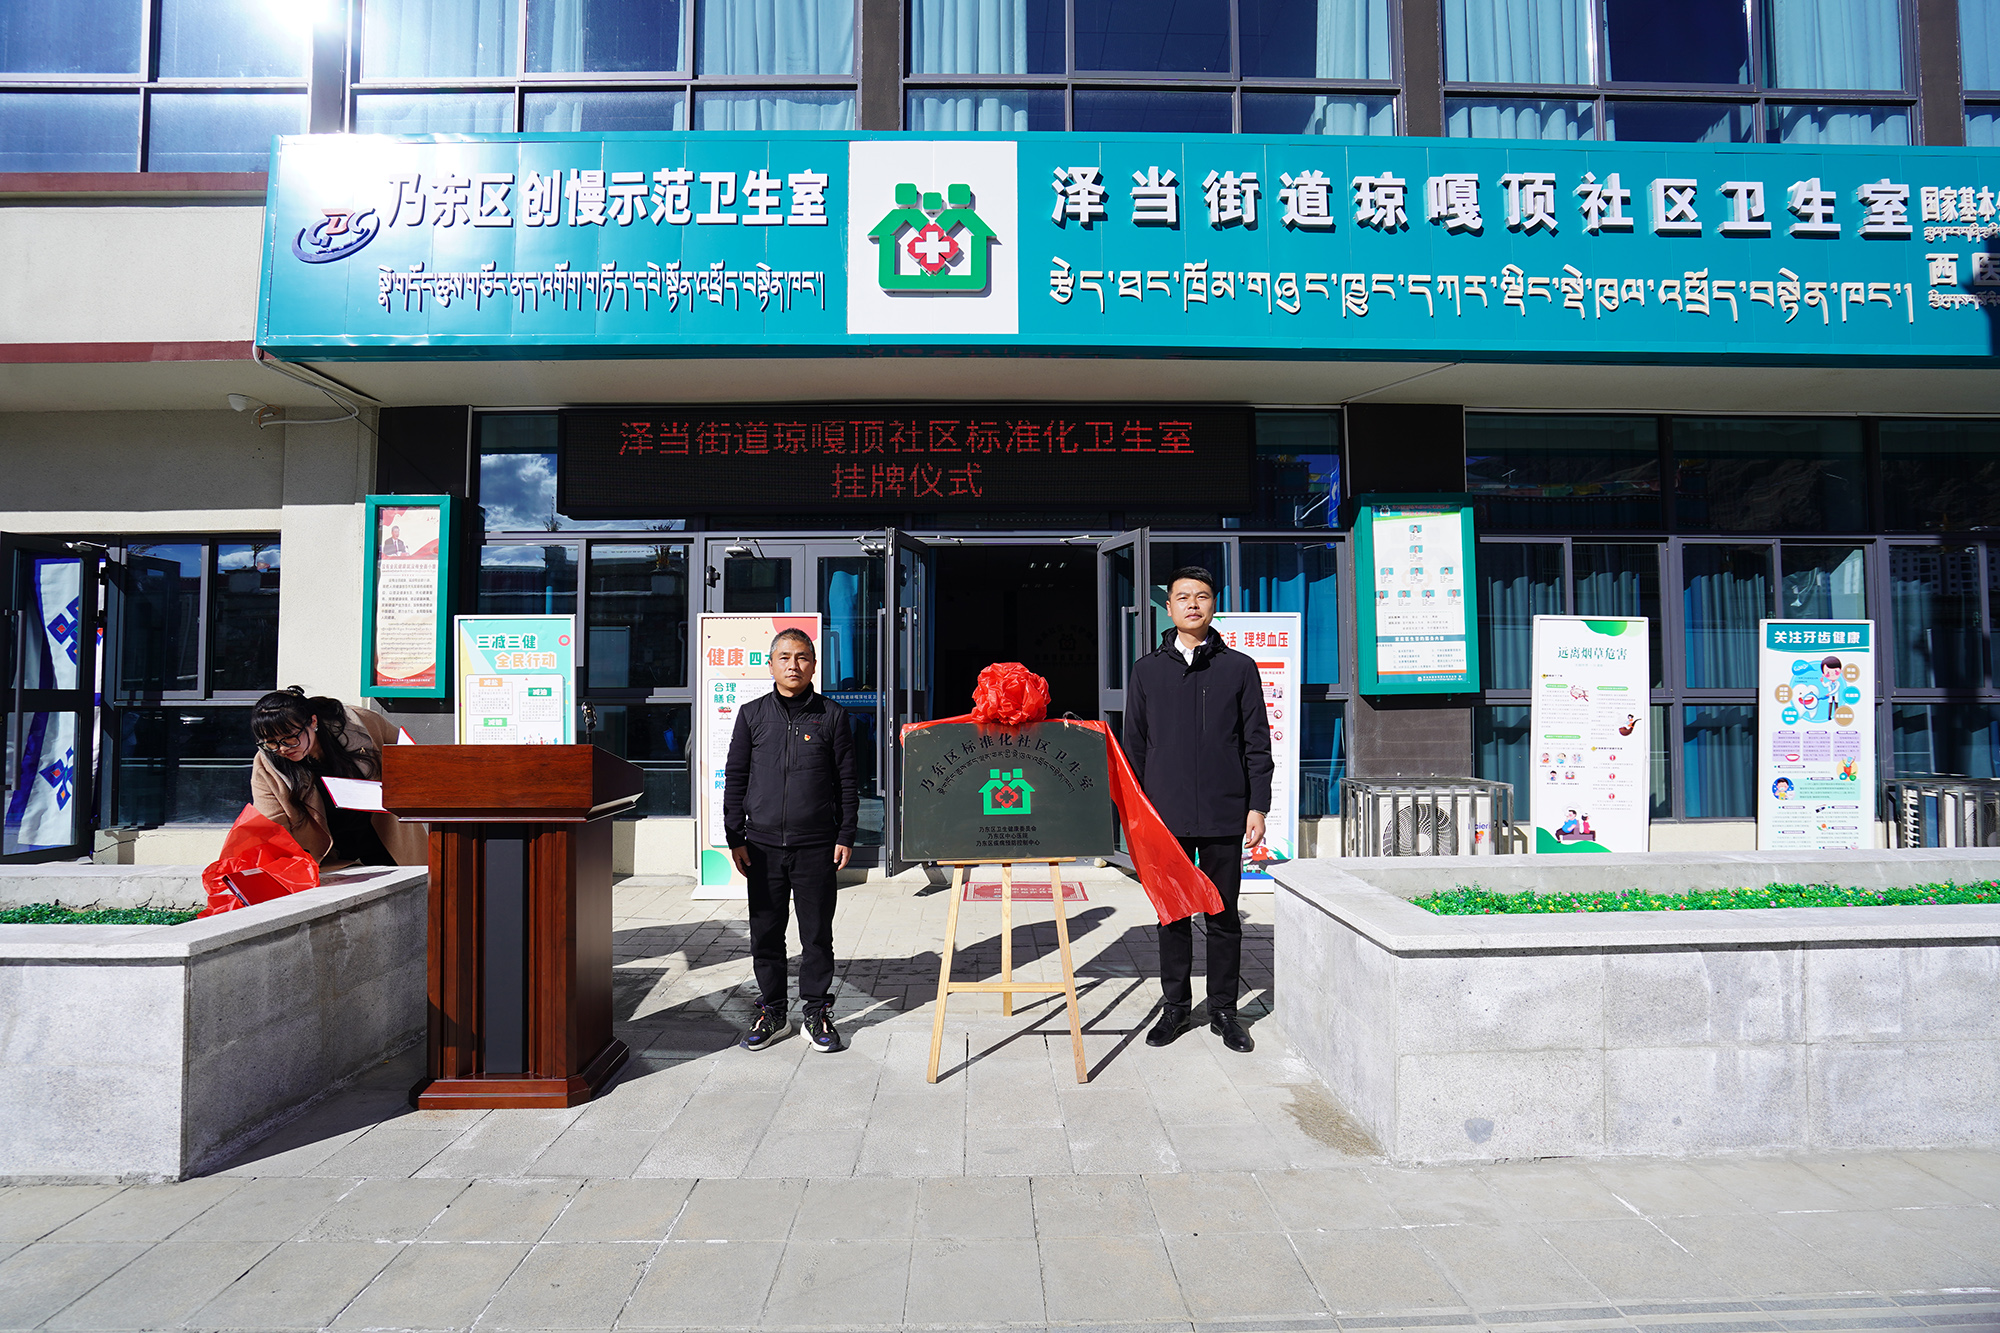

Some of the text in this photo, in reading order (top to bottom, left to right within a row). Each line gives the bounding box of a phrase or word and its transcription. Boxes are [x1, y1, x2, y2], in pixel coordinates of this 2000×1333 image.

[388, 168, 829, 227] 乃东区创慢示范卫生室
[1052, 166, 1913, 239] 泽当街道琼嘎顶社区卫生室
[1921, 186, 2000, 223] 国家基本
[619, 420, 1196, 456] 泽当街道琼嘎顶社区标准化卫生室
[832, 462, 983, 499] 挂牌仪式
[477, 634, 537, 649] 三减三健
[1244, 631, 1289, 648] 理想血压
[1774, 630, 1861, 644] 关注牙齿健康
[496, 652, 556, 668] 全民行动
[1557, 646, 1628, 660] 远离烟草危害
[714, 682, 737, 693] 合理
[714, 694, 736, 703] 膳食
[919, 732, 1094, 793] 乃东区标准化社区卫生室
